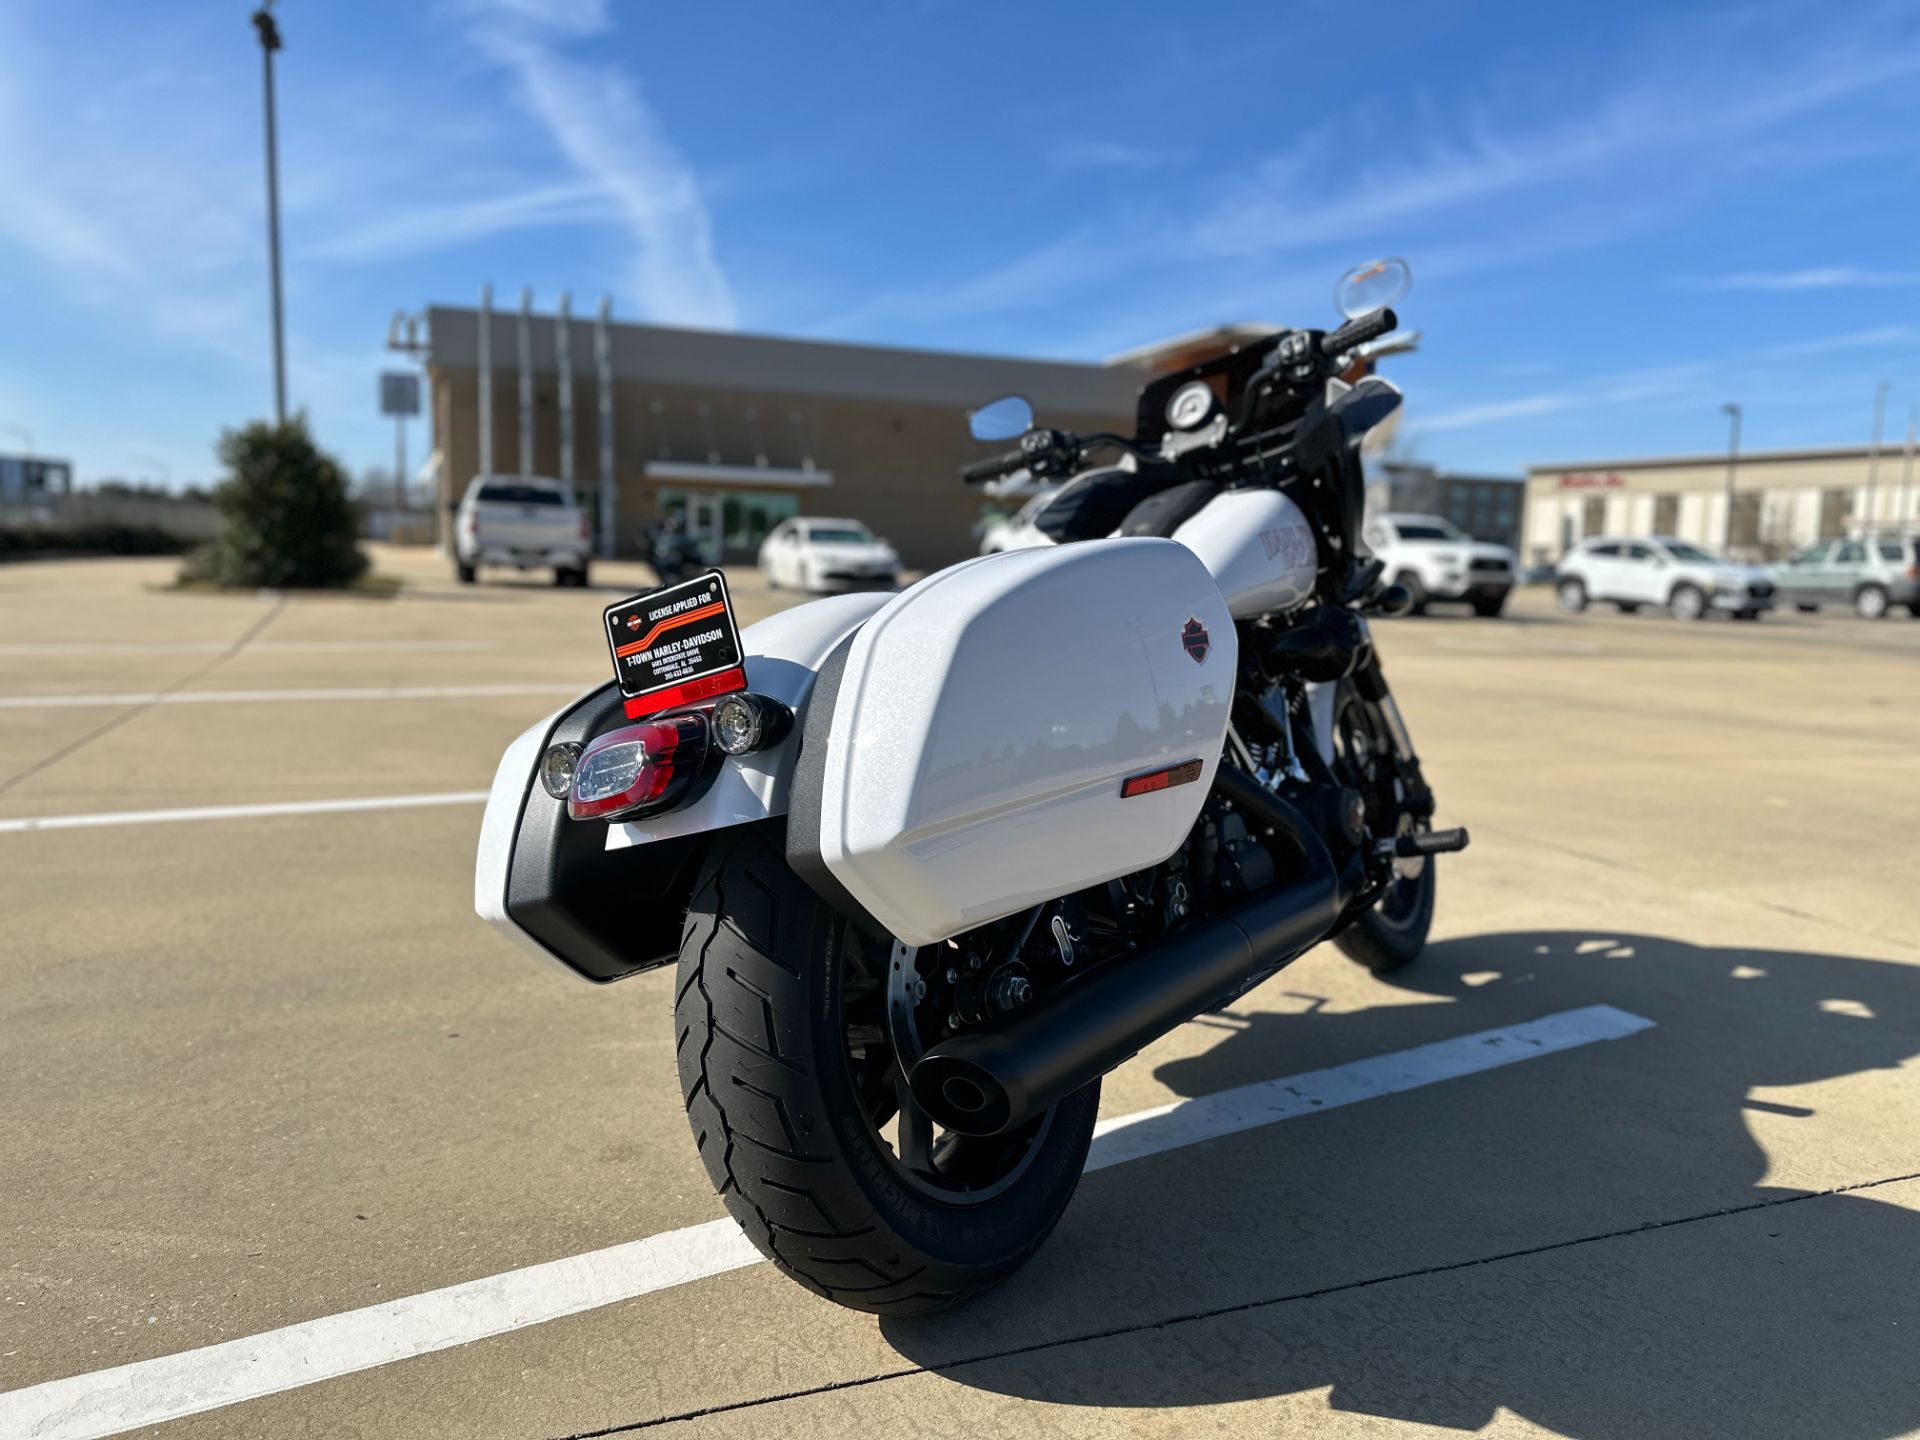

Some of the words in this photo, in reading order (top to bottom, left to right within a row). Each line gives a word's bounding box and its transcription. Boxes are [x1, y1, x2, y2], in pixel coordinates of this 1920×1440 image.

[648, 607, 673, 621] LICENSE
[672, 596, 698, 613] APPLIED
[698, 592, 712, 606] FOR
[626, 650, 653, 667] T-TOWN
[653, 628, 723, 660] HARLEY-DAVIDSON
[662, 651, 687, 665] INTERSTATE
[686, 648, 701, 659] DRIVE
[840, 1114, 922, 1224] MICHELIN
